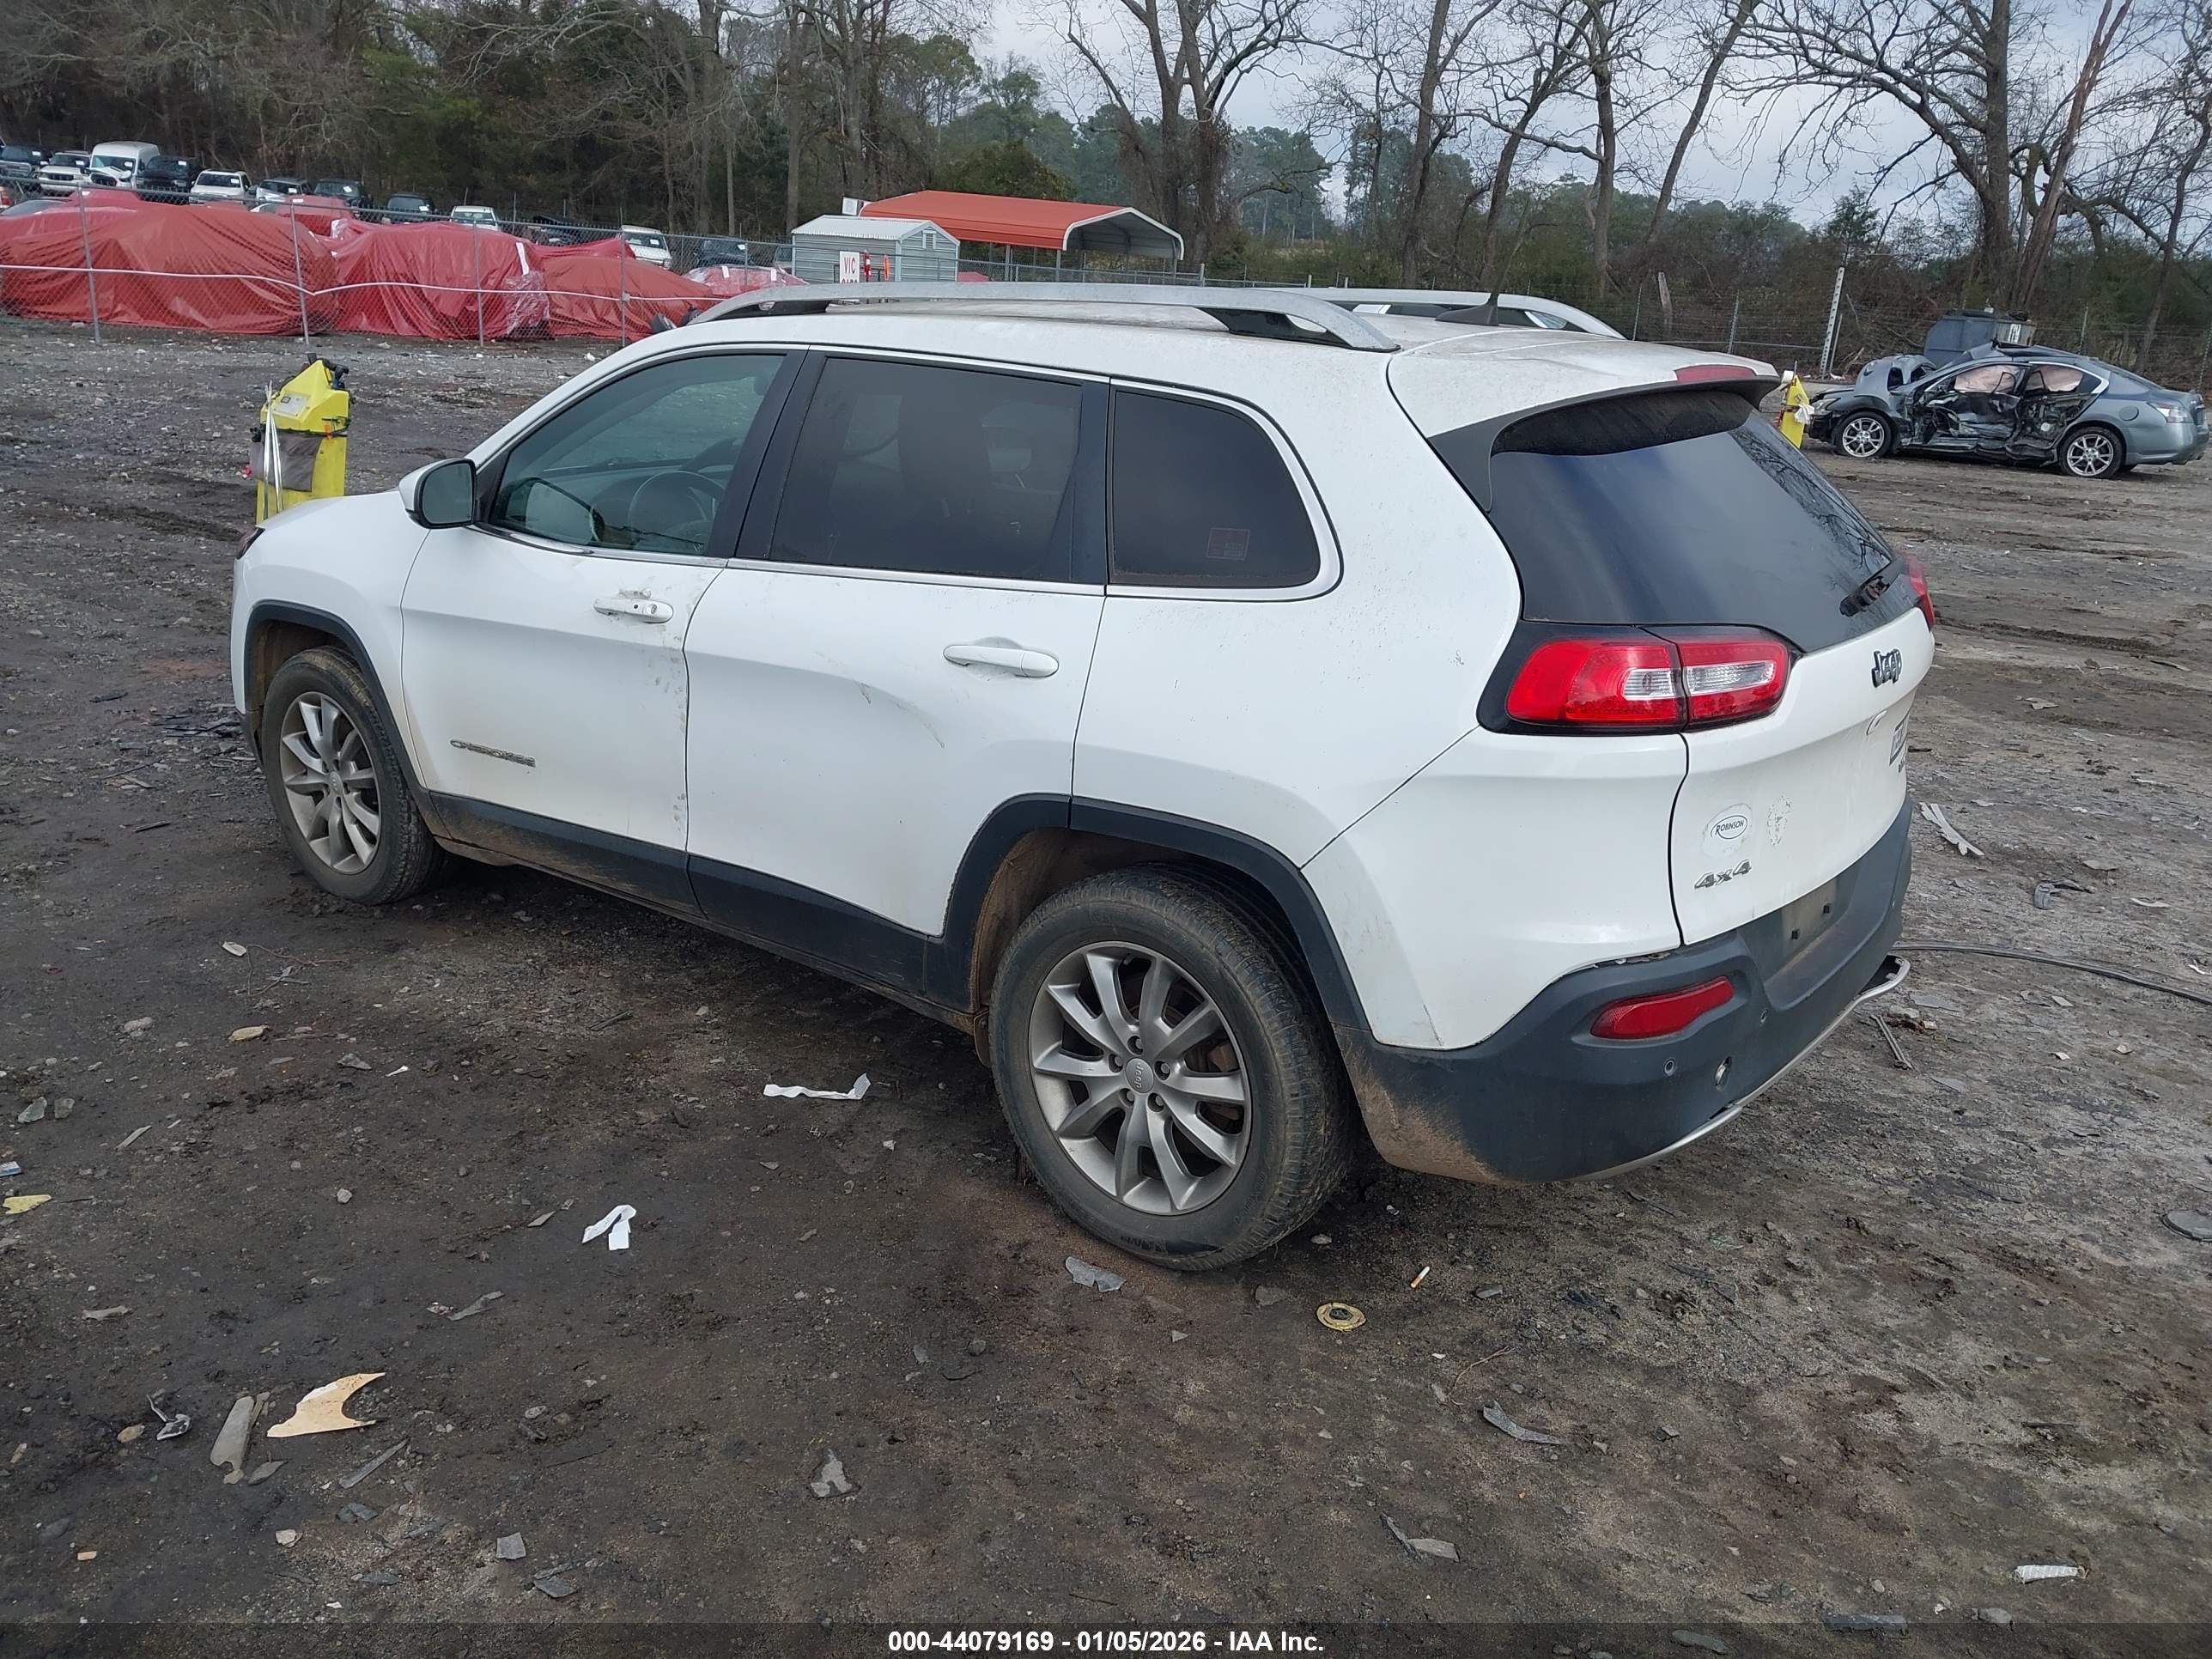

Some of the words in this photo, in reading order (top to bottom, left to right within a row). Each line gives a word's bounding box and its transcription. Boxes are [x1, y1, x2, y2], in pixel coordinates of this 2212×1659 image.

[843, 256, 856, 275] VIC
[1870, 648, 1903, 689] Jeep
[1714, 818, 1746, 836] ROBINSON
[1693, 859, 1753, 890] 4x4
[1133, 1062, 1145, 1090] Jeep
